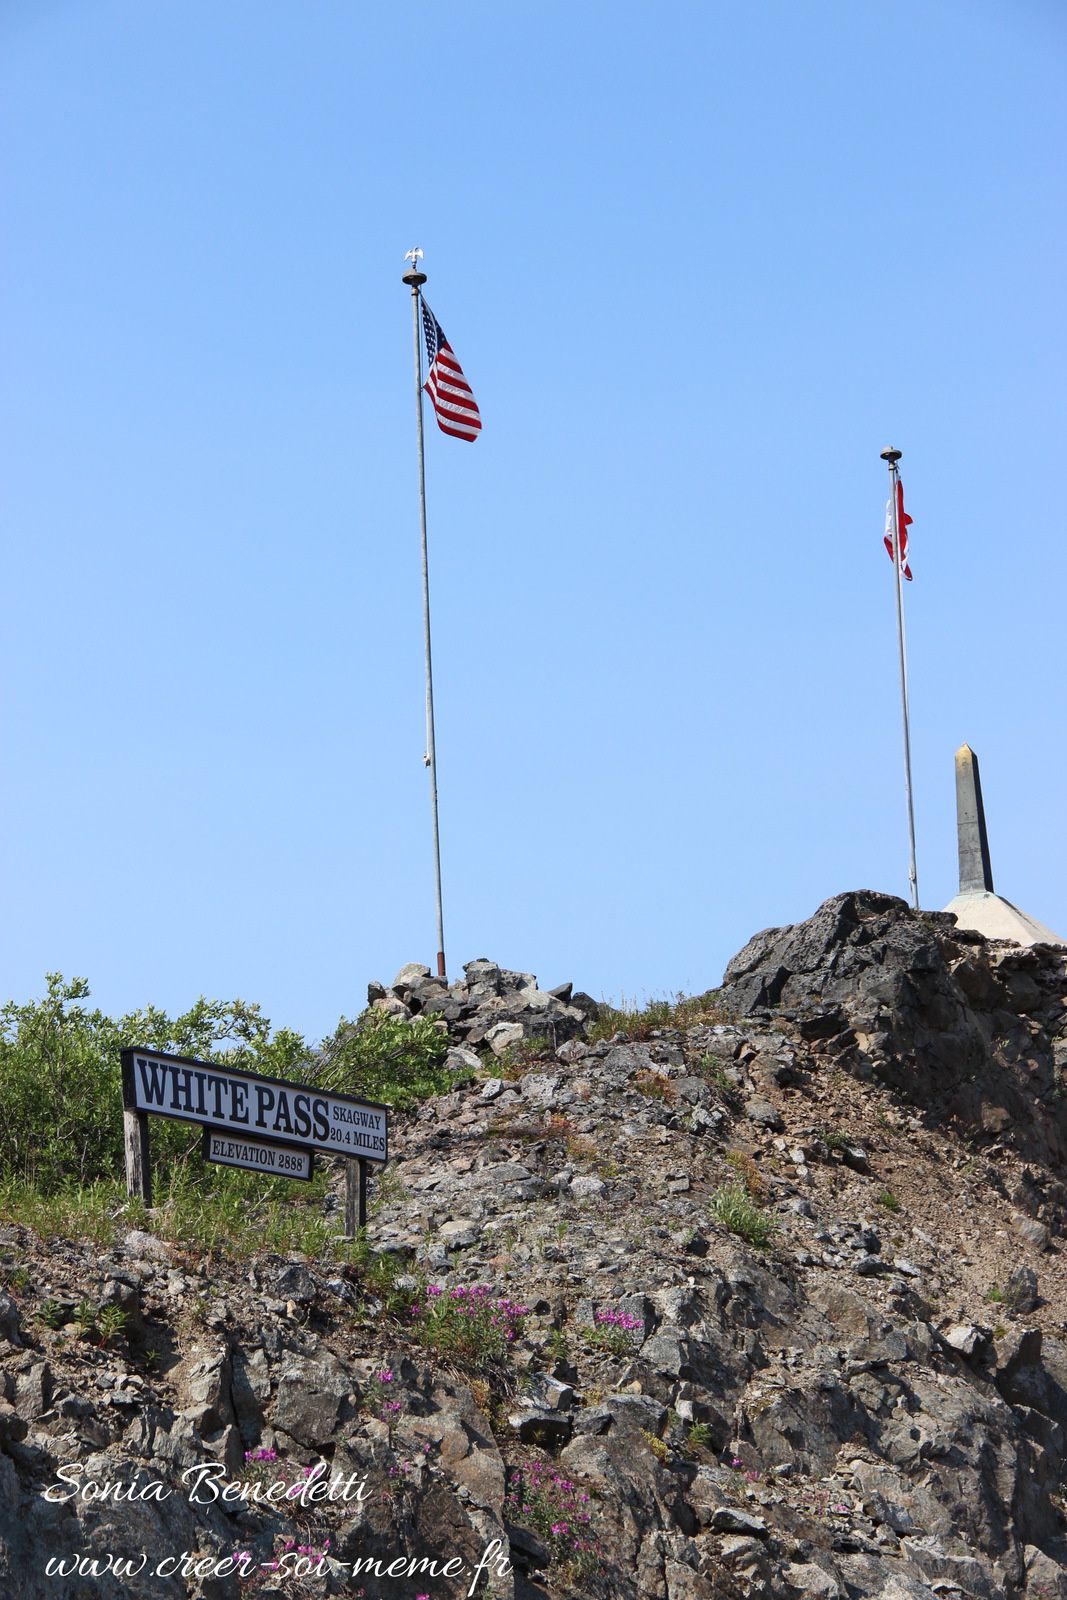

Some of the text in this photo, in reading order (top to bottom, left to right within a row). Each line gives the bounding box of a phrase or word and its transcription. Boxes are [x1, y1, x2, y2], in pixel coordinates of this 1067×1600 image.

[137, 1059, 330, 1142] WHITE PASS
[333, 1106, 381, 1130] SKAGWAY
[330, 1127, 385, 1152] 20.4 MILES
[212, 1140, 276, 1166] ELEVATION
